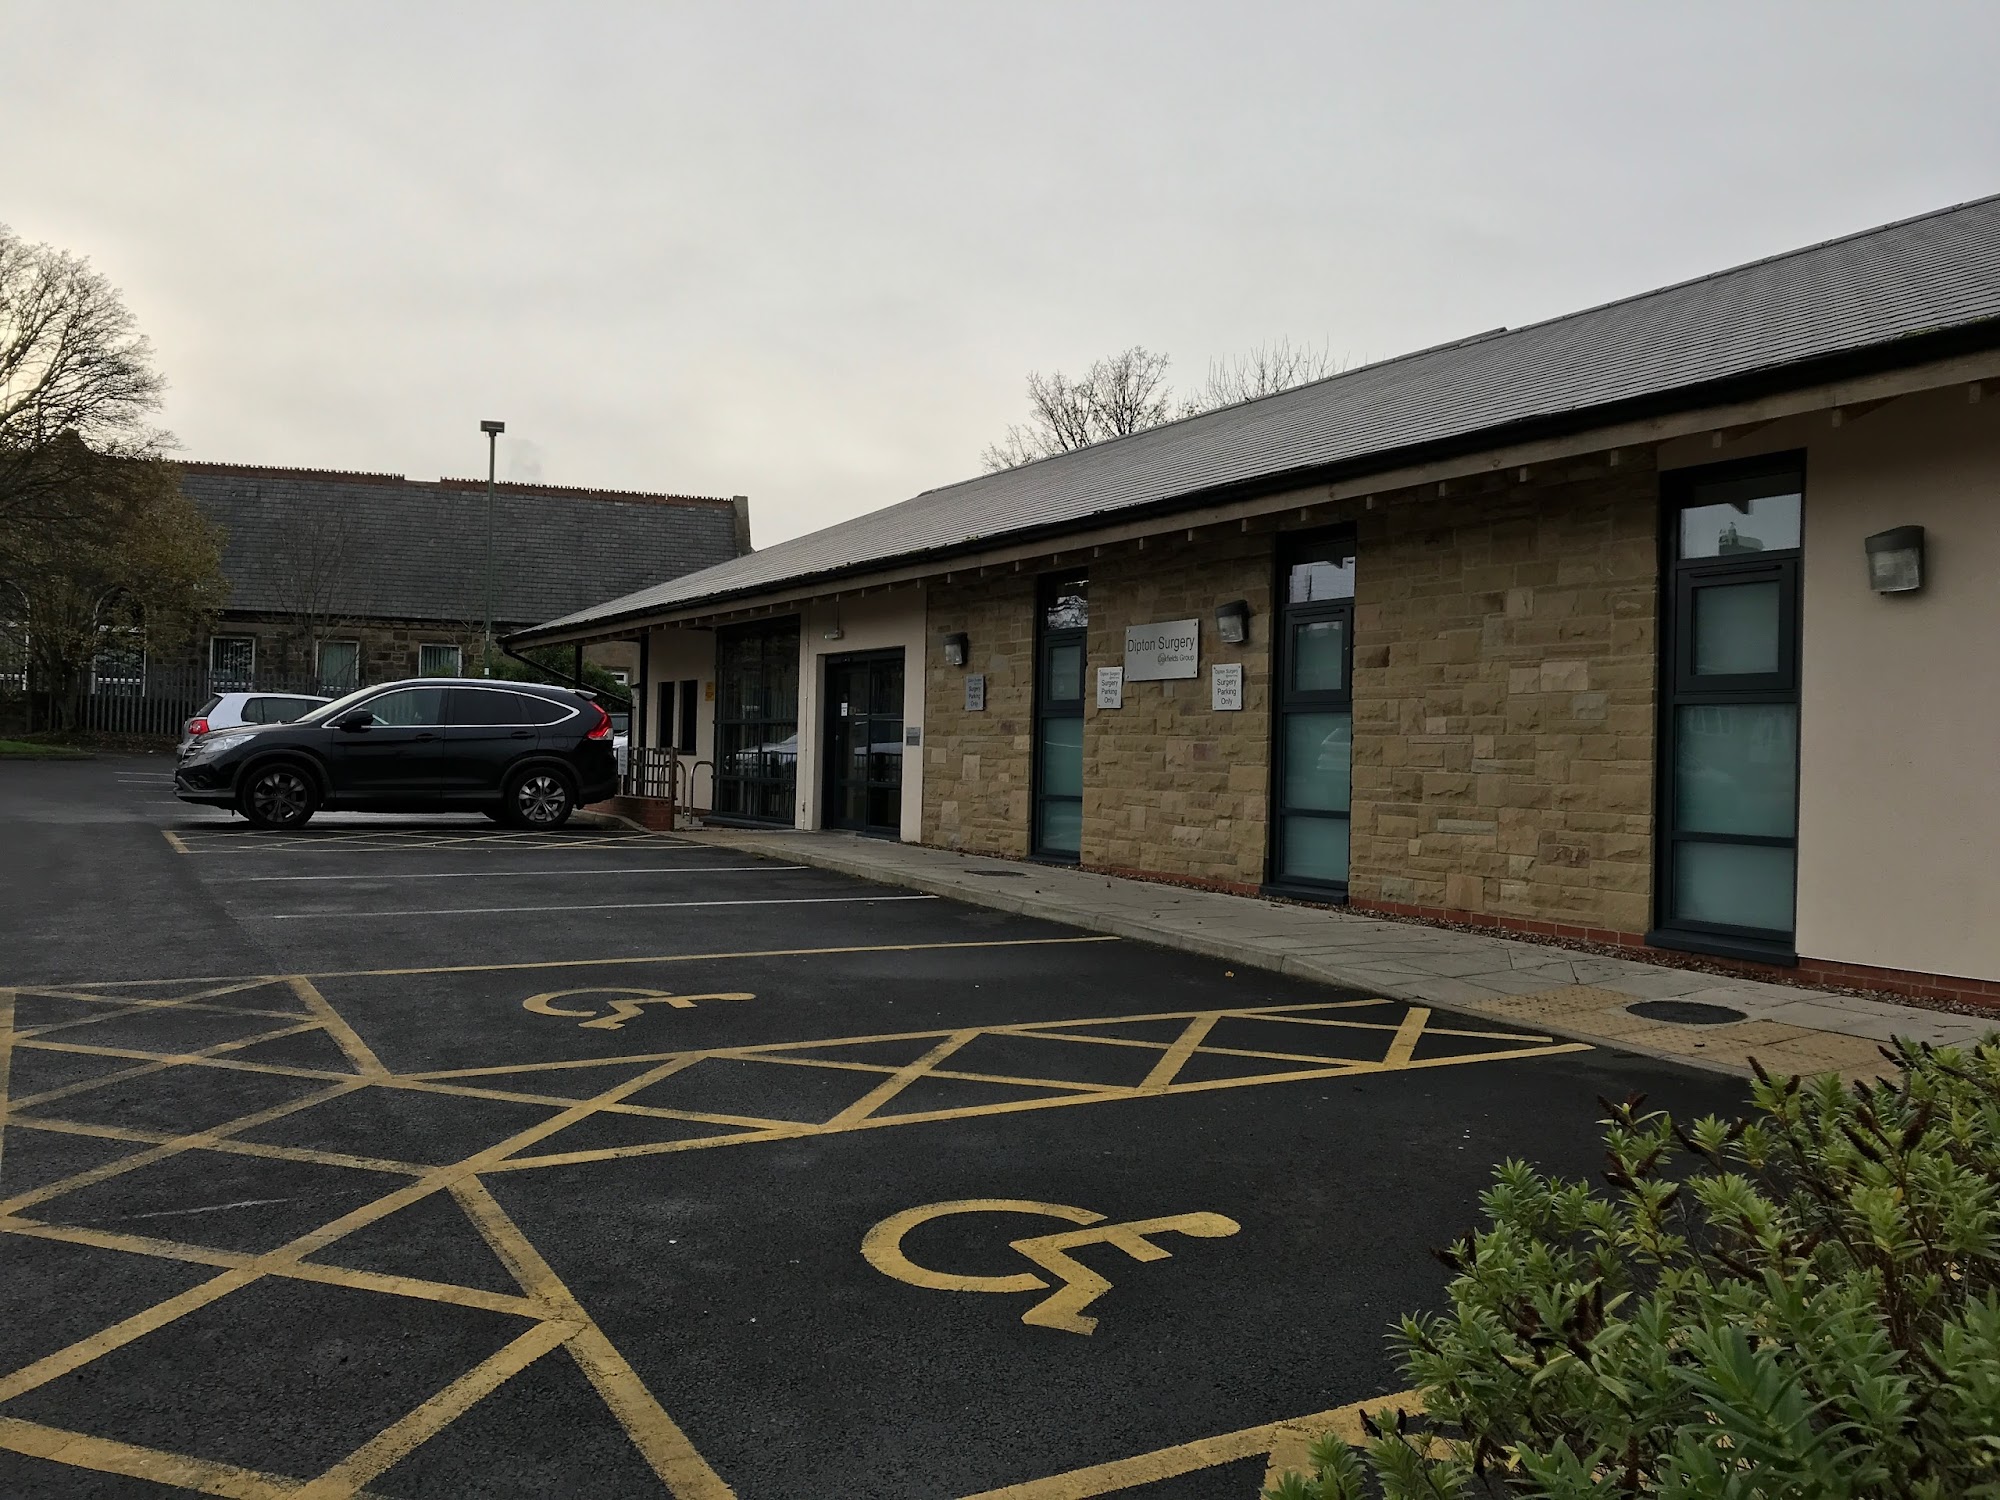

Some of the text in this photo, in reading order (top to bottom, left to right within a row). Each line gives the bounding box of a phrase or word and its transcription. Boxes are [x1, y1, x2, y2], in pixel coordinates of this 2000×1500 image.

[1127, 636, 1195, 655] Dipton Surgery
[1180, 653, 1195, 662] Group
[1101, 679, 1118, 688] Surgery
[1216, 678, 1237, 687] Surgery
[1101, 688, 1118, 697] Parking
[1217, 688, 1237, 697] Parking
[1103, 696, 1114, 705] Only
[1220, 697, 1233, 706] Only
